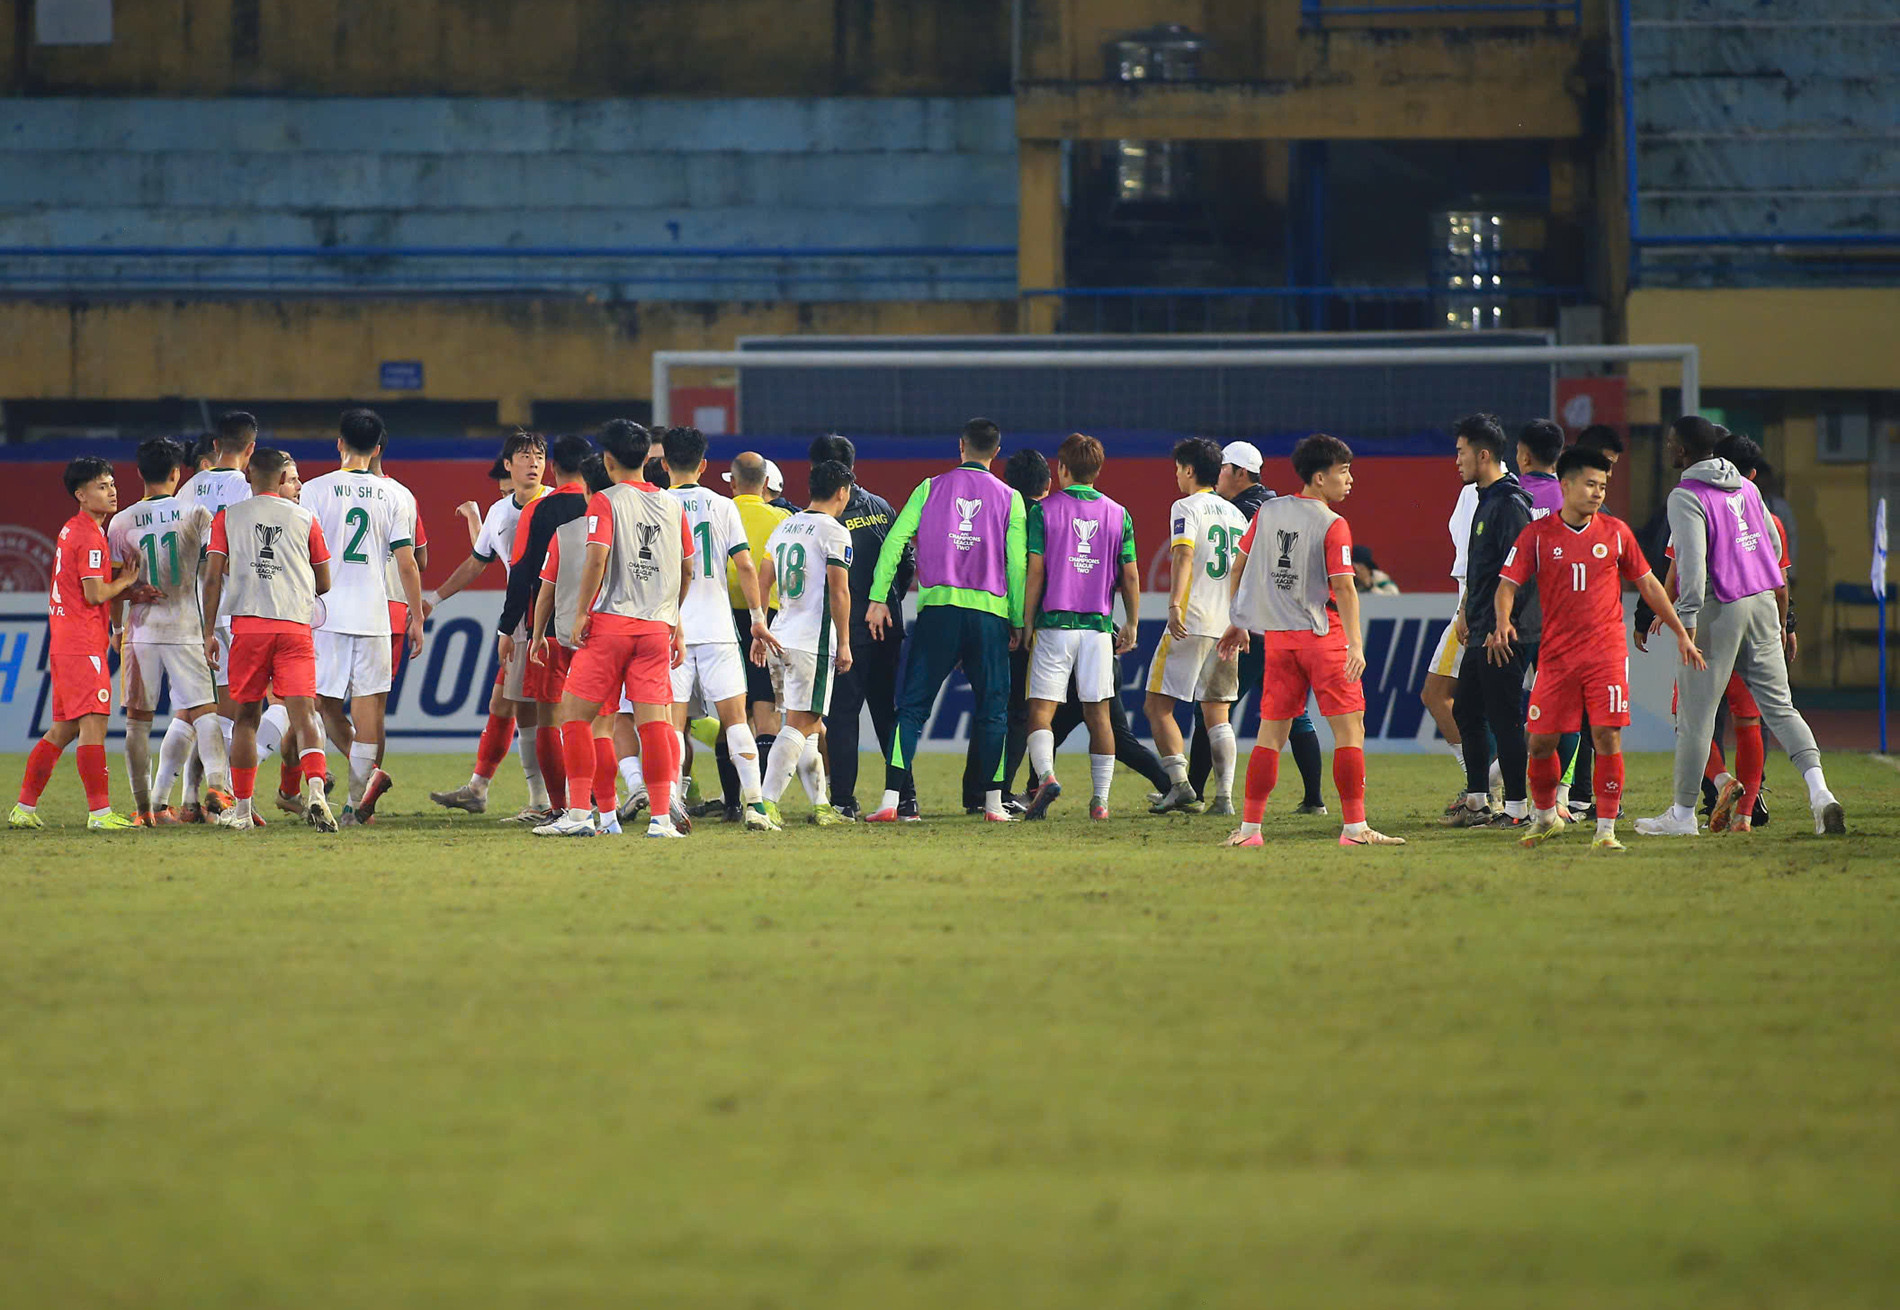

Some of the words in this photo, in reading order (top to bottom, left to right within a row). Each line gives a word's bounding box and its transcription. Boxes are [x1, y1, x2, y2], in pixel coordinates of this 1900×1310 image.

[334, 485, 351, 497] WU
[683, 500, 698, 512] NG
[135, 513, 153, 527] LIN
[845, 514, 888, 531] BEIJING
[344, 507, 370, 564] 2
[692, 521, 714, 579] 1
[139, 531, 181, 588] 11
[1206, 524, 1245, 580] 35
[776, 543, 806, 599] 18
[1571, 562, 1586, 592] 11
[1608, 684, 1622, 713] 11
